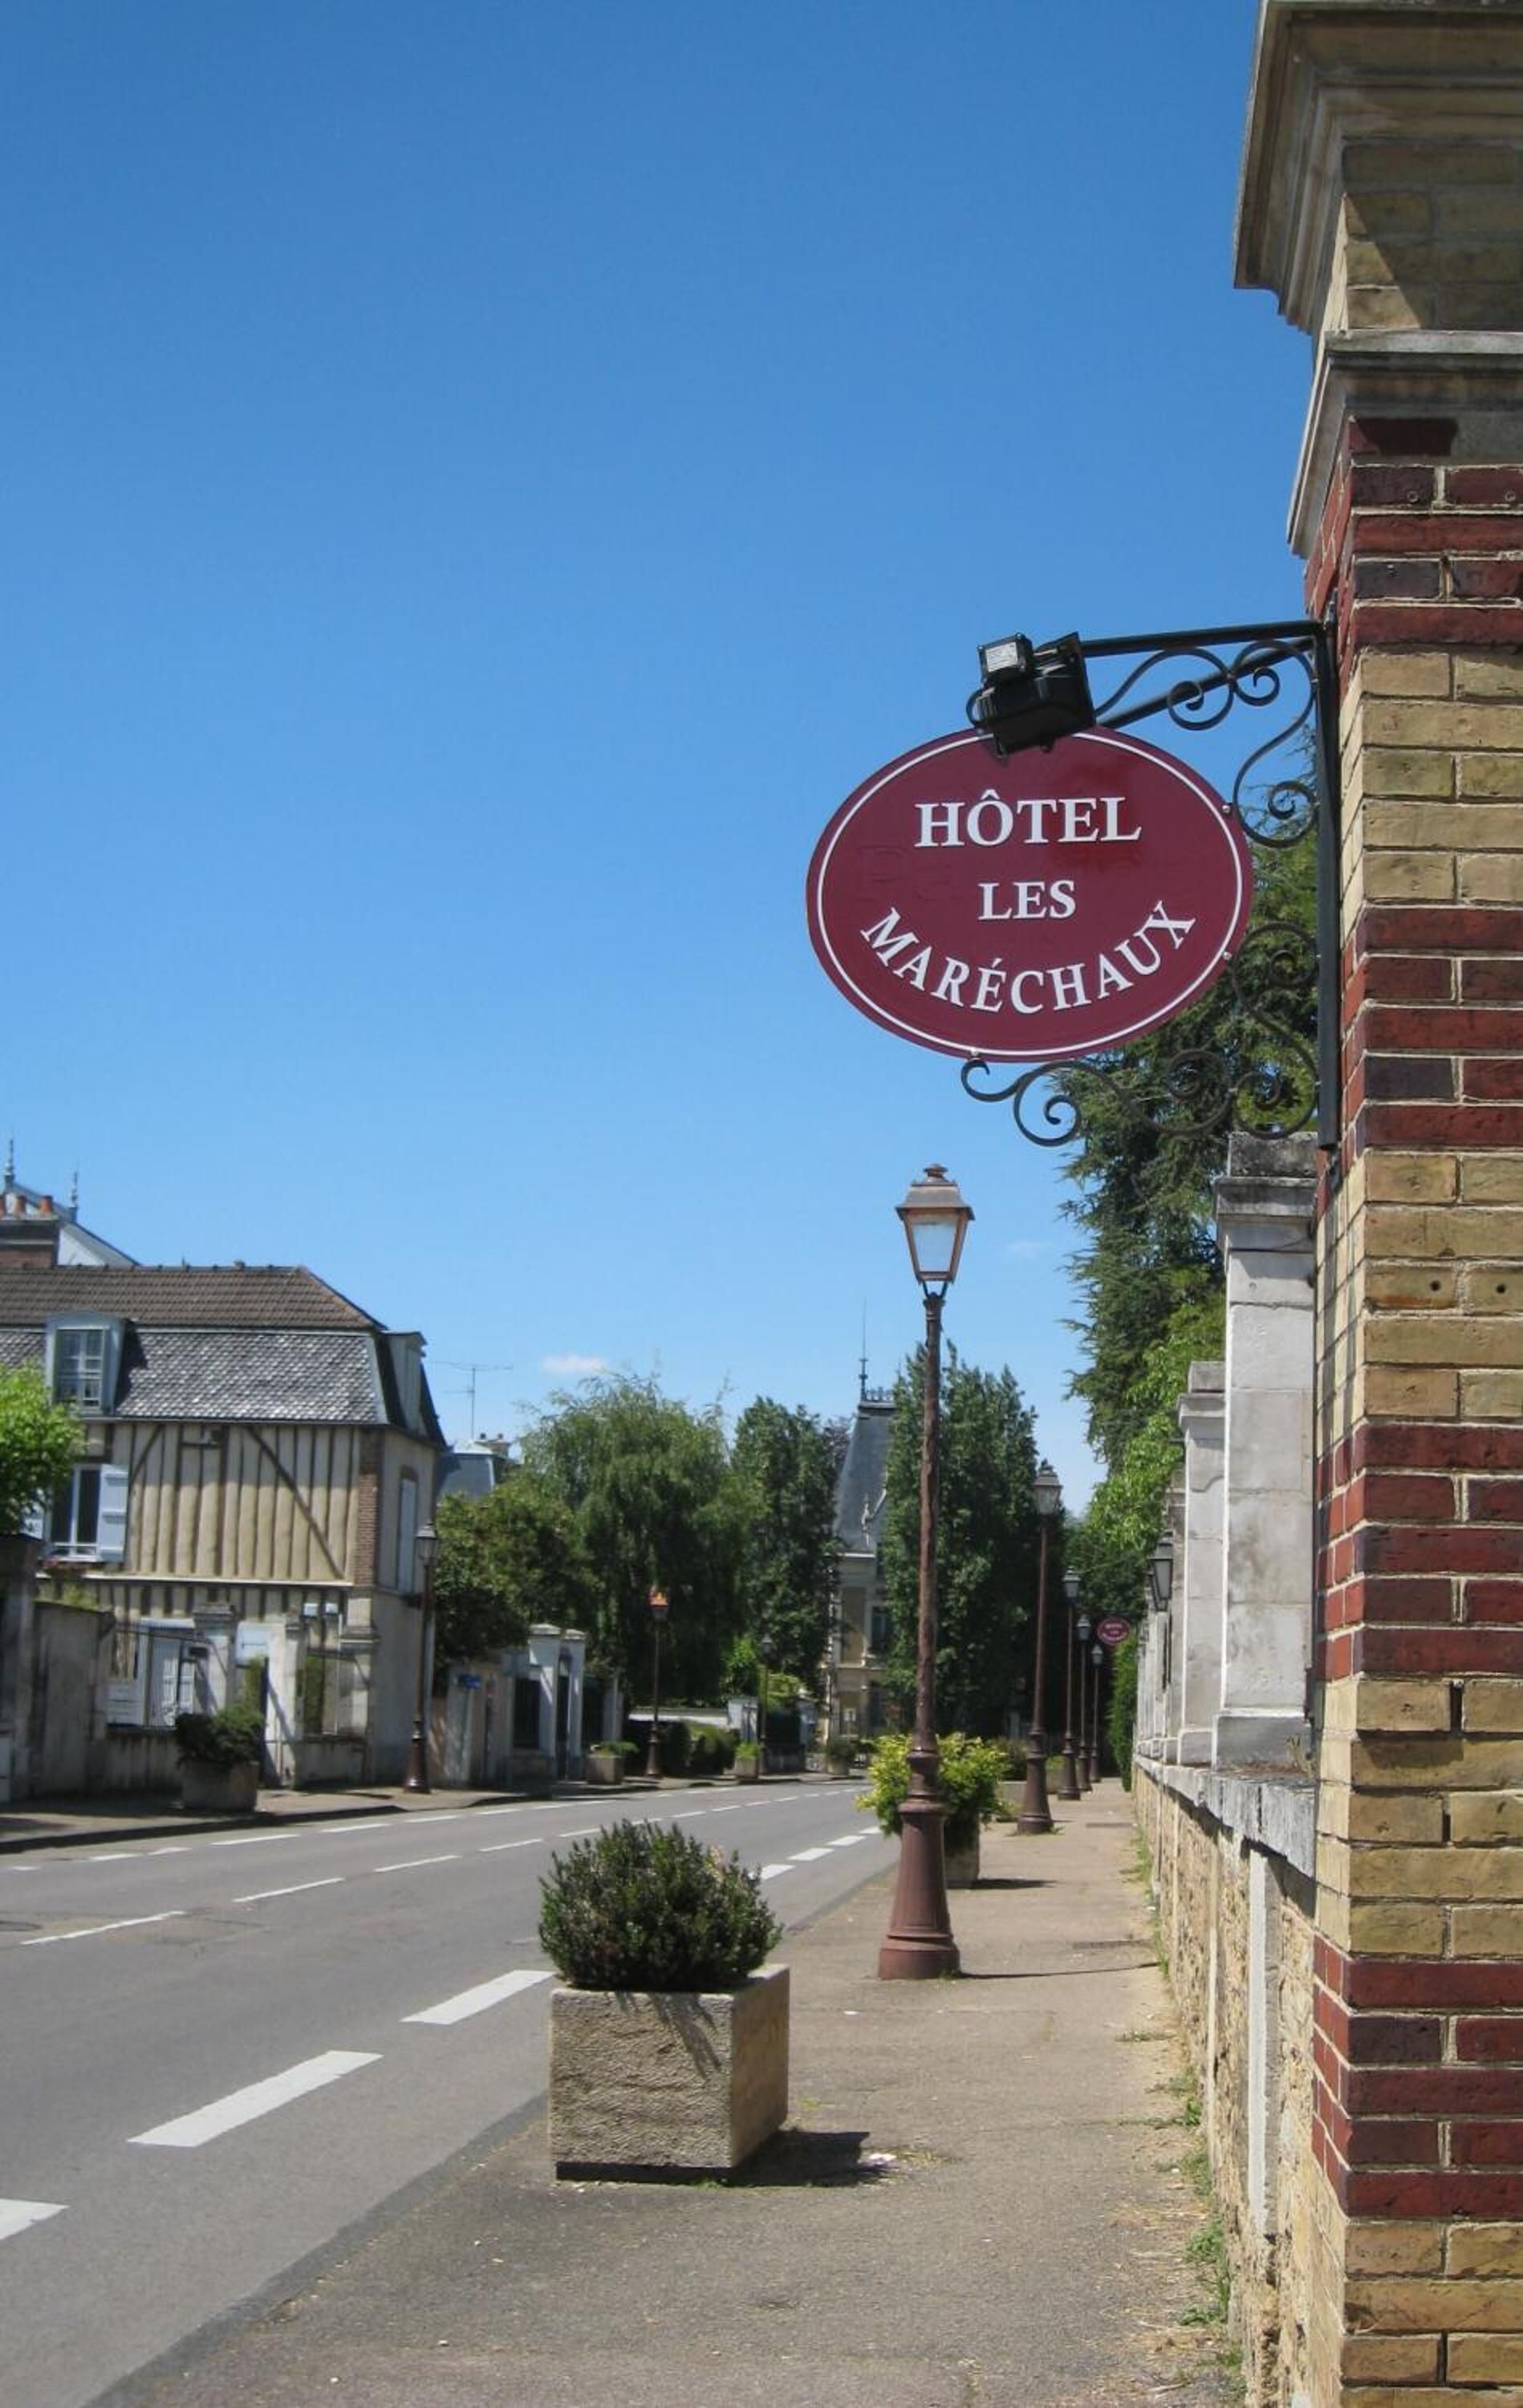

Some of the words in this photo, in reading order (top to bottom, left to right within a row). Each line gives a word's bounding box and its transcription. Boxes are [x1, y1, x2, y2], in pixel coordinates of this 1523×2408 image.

[914, 789, 1142, 848] HÔTEL
[978, 880, 1076, 921] LES
[860, 900, 1196, 1014] MARÉCHAUX
